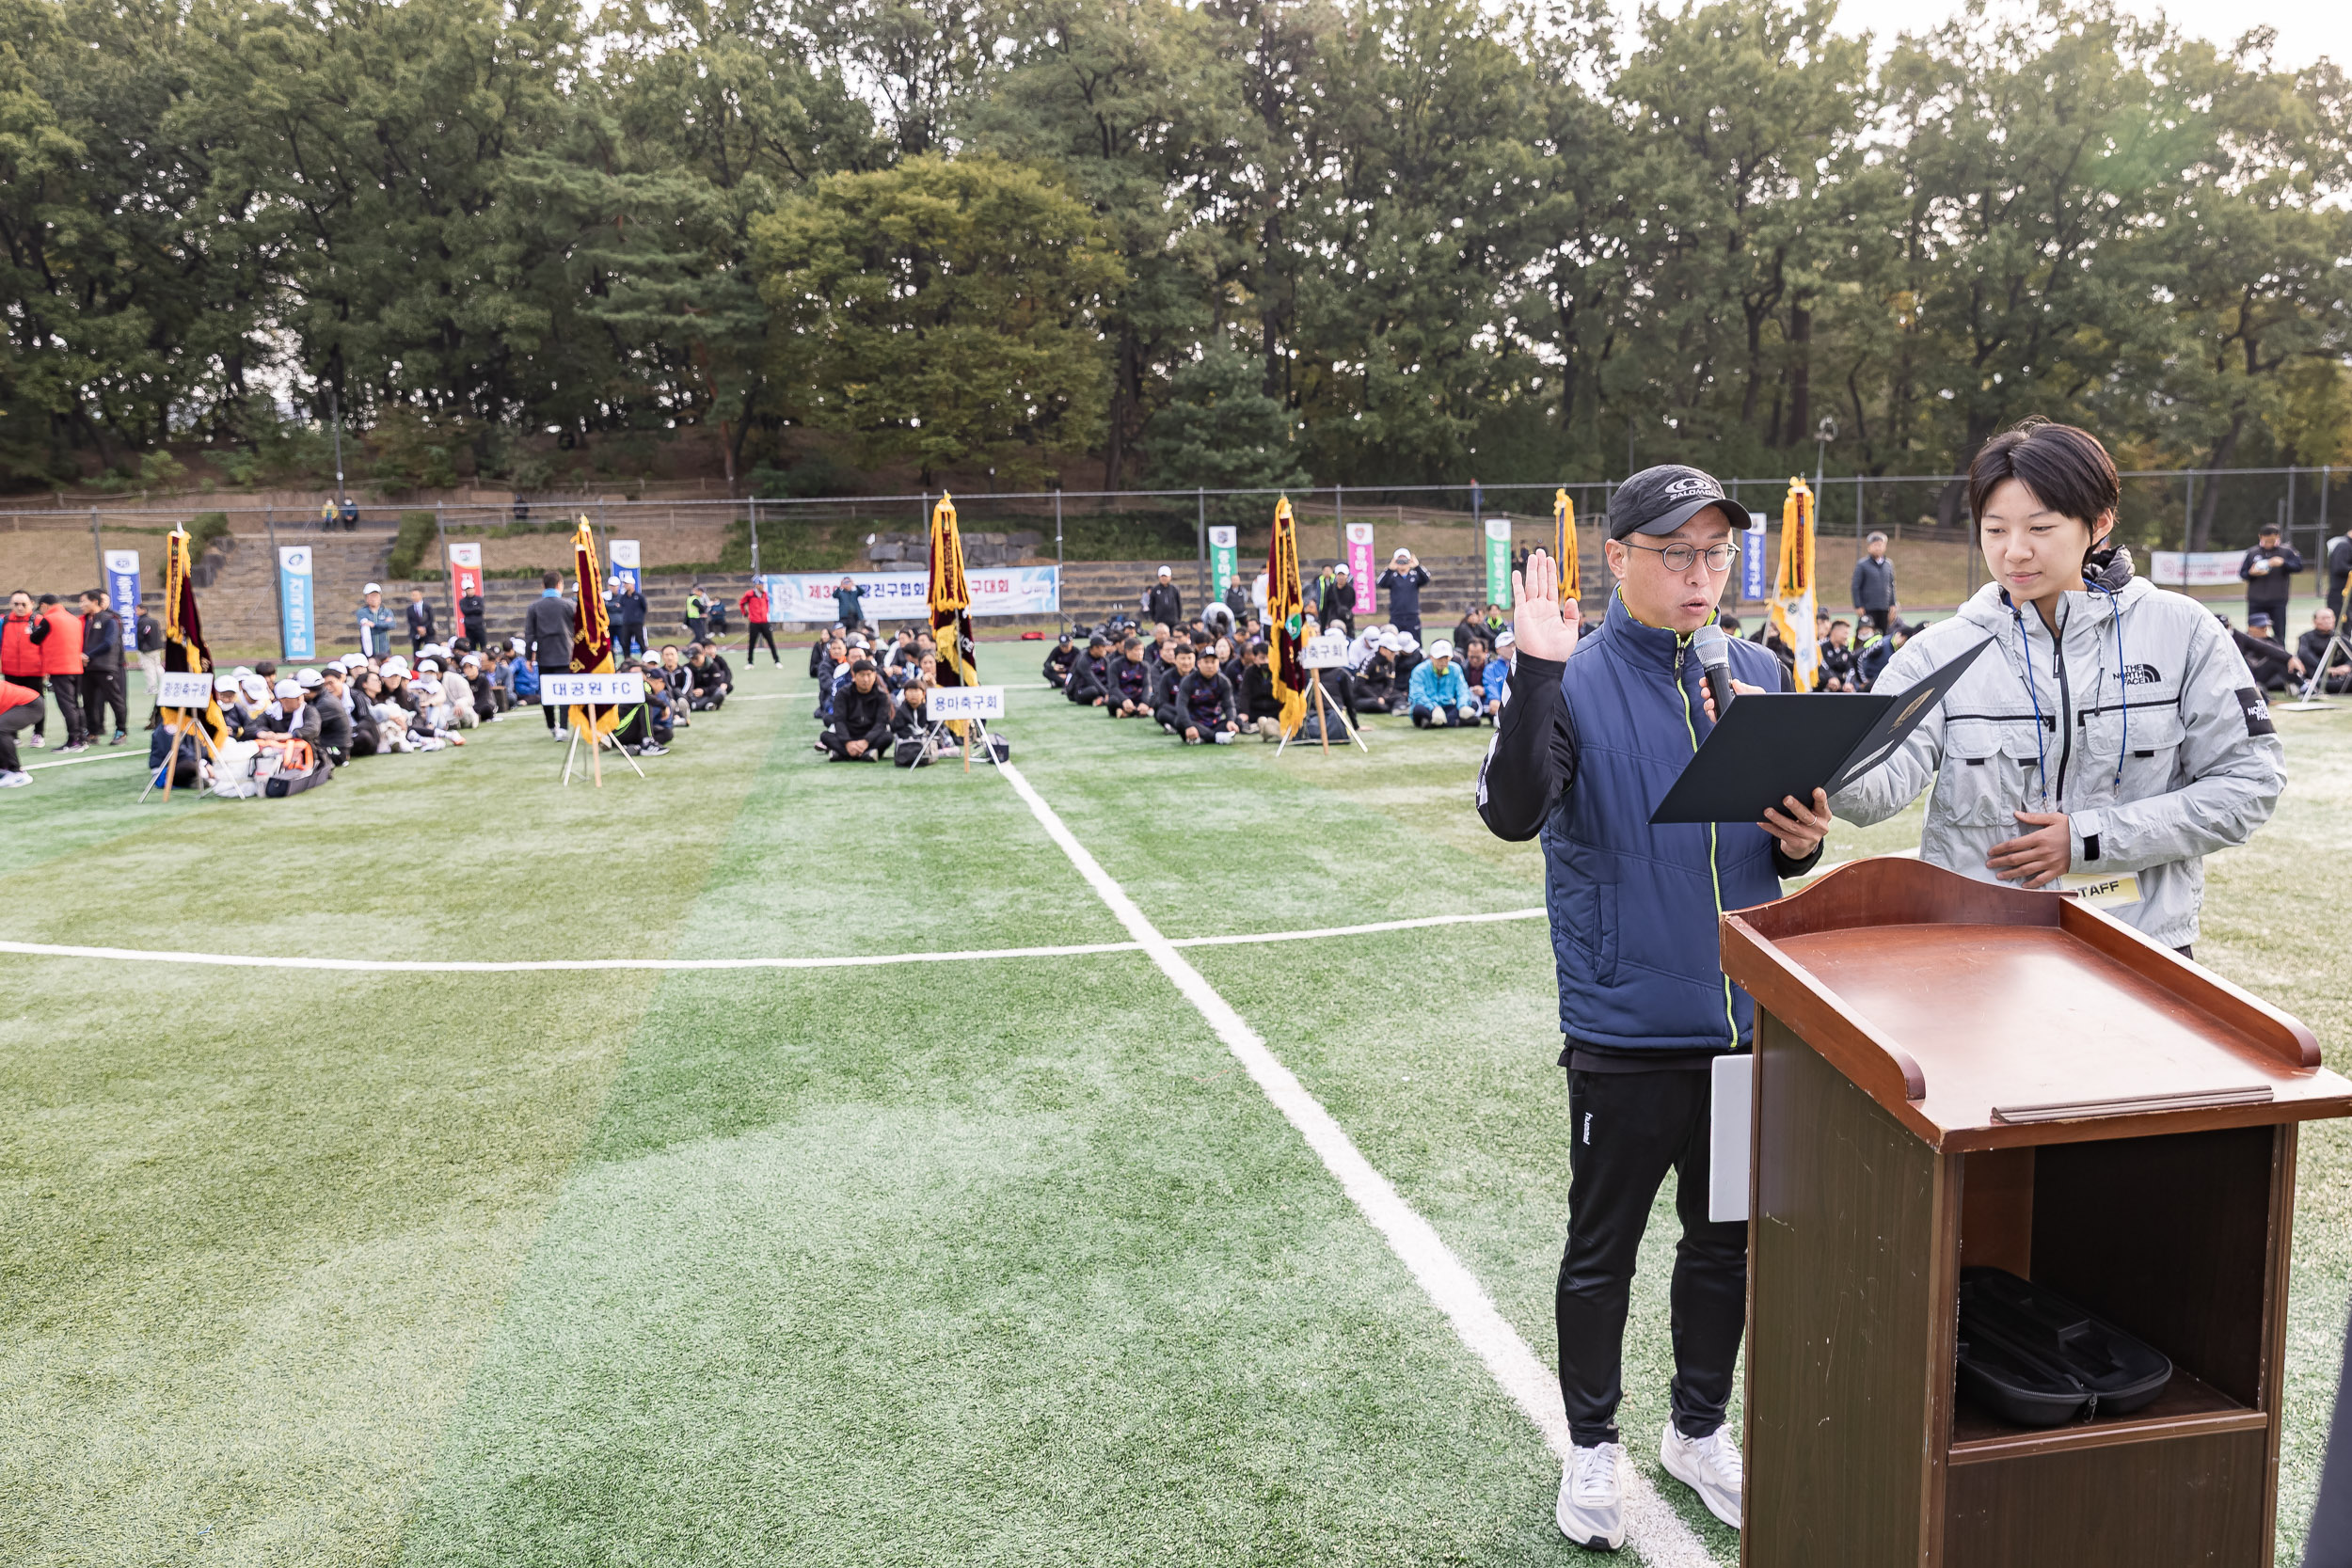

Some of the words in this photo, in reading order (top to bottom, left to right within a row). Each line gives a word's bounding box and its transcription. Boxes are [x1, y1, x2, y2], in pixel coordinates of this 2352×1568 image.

[2123, 663, 2142, 673] THE
[552, 681, 602, 696] 대공원
[612, 681, 630, 695] FC
[935, 694, 997, 712] 용마축구회
[2070, 879, 2120, 898] TAFF
